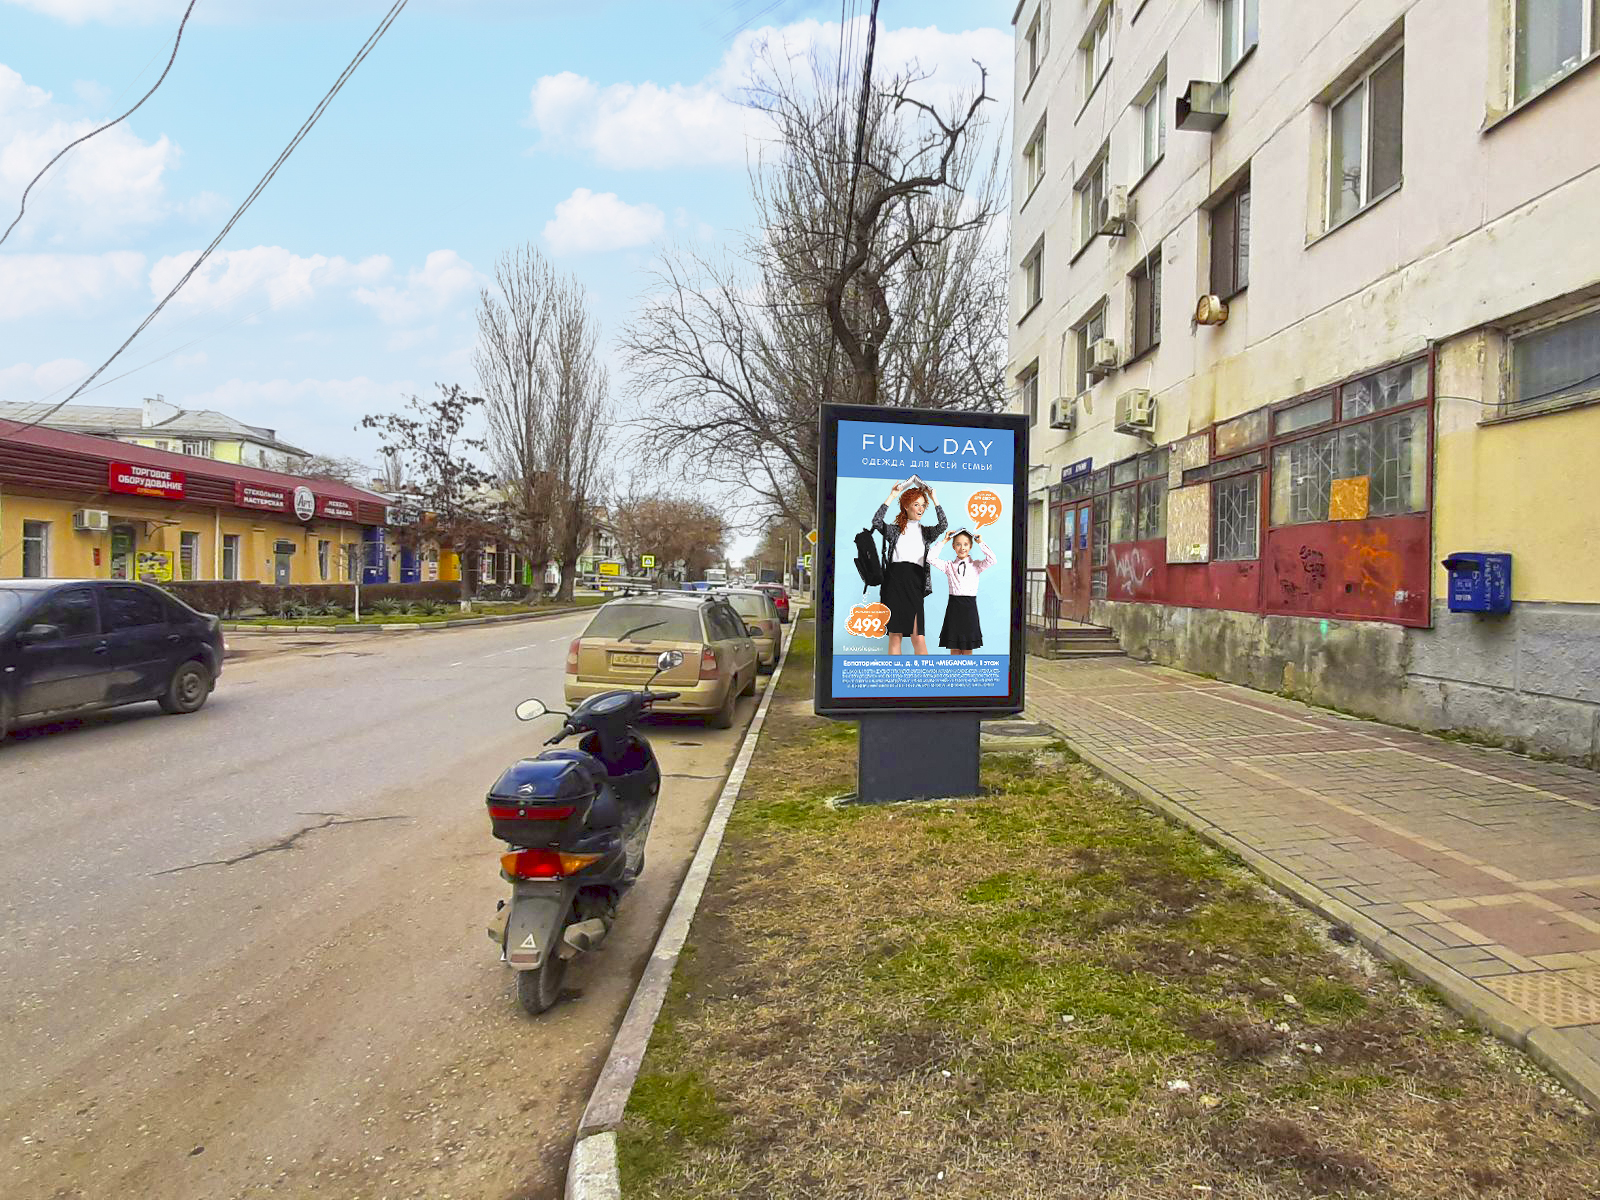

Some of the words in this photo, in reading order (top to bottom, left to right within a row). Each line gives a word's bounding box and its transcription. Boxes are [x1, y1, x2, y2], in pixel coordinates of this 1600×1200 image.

[862, 433, 914, 453] FUN
[943, 438, 993, 457] DAY
[861, 457, 905, 468] ОДЕЖДА
[910, 460, 930, 469] ДЛЯ
[934, 459, 957, 470] ВСЕЙ
[962, 462, 993, 472] СЕМЬИ
[131, 466, 171, 480] ТОРГОВОЕ
[118, 474, 183, 491] ОБОРУДОВАНИЕ
